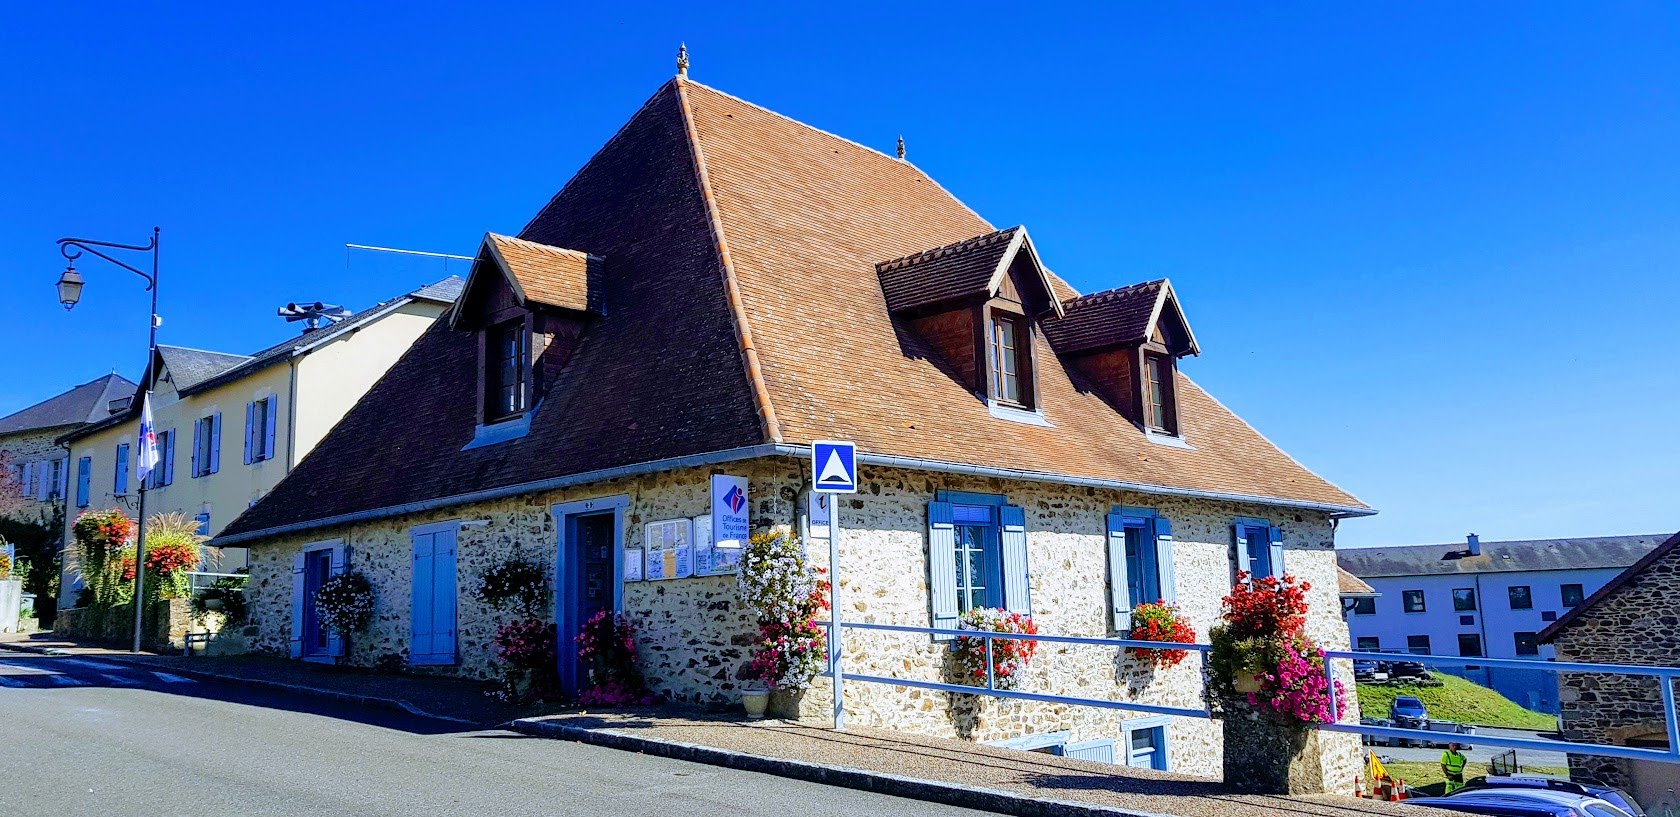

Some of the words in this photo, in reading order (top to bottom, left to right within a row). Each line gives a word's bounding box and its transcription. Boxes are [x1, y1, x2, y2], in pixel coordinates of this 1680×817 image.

[722, 514, 742, 523] Offices
[722, 522, 747, 531] Tourisme
[729, 531, 747, 540] France
